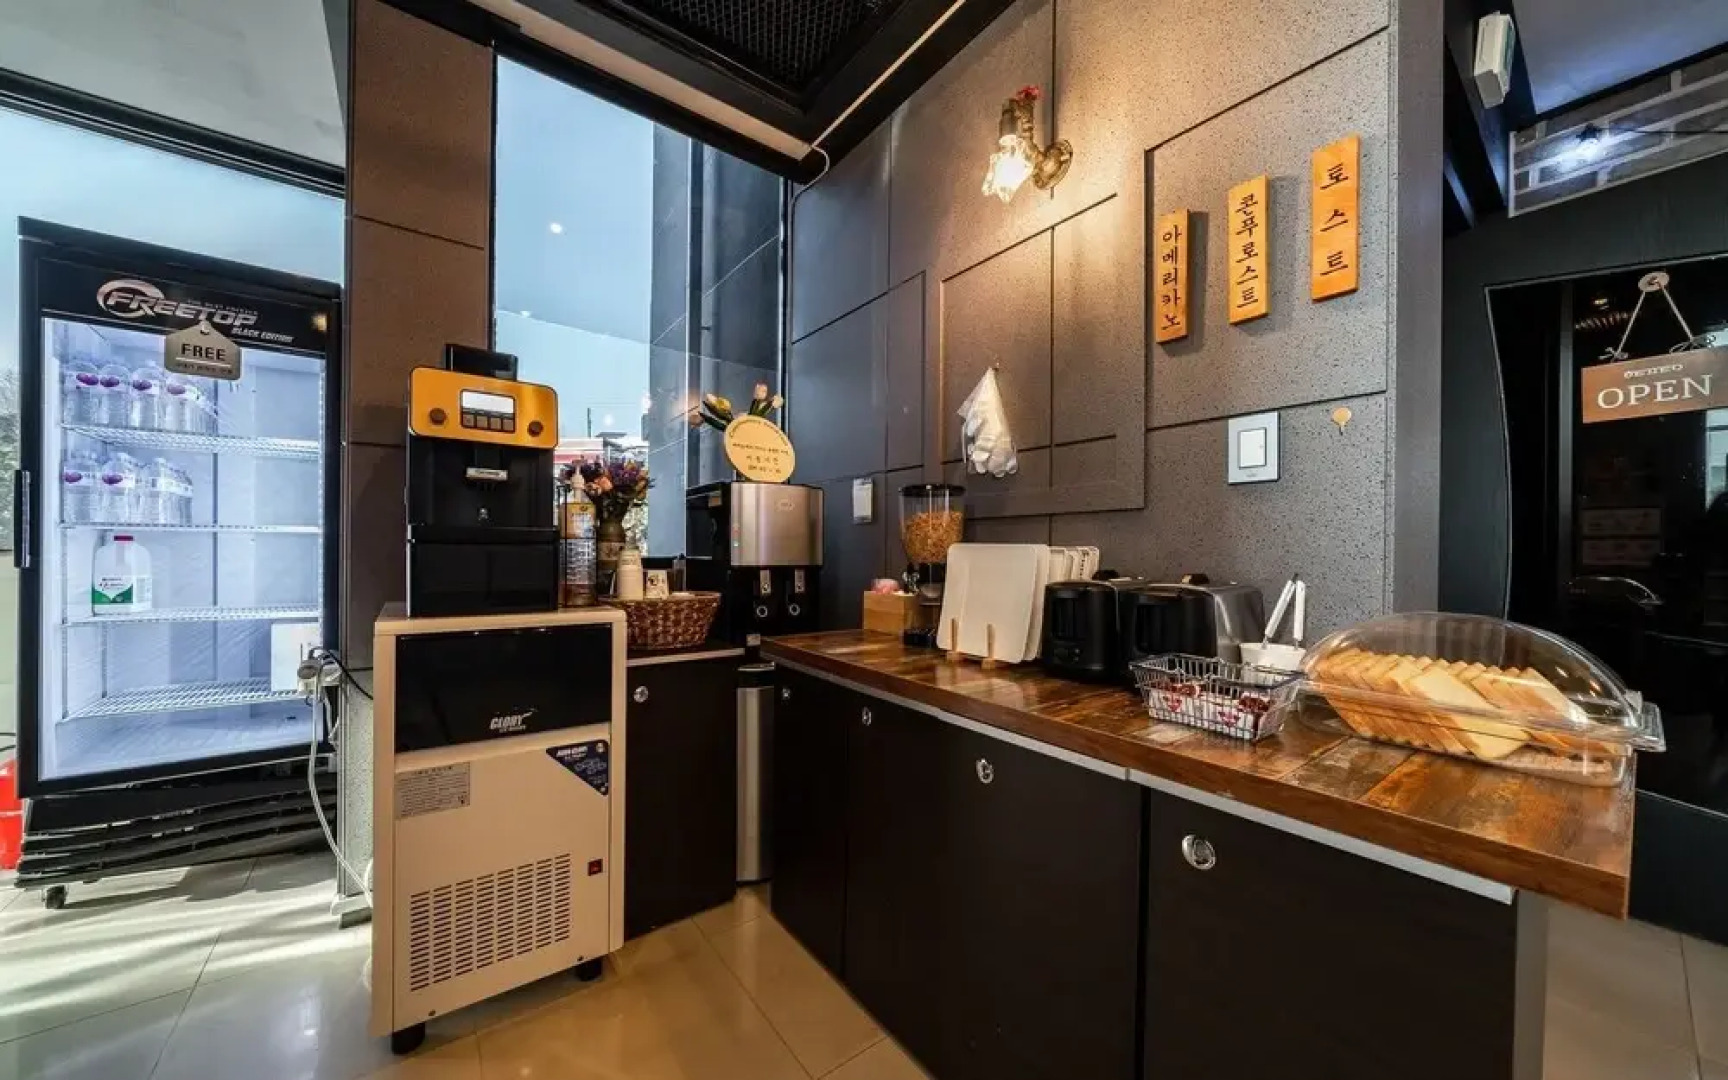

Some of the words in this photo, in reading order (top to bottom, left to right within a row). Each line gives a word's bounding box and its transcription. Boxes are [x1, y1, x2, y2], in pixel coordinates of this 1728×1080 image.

[1320, 162, 1348, 276] 토스트
[1235, 193, 1259, 309] 콘푸로스트
[1161, 224, 1182, 331] 아메리카노
[106, 290, 258, 326] FREETOP
[181, 343, 227, 361] FREE
[231, 327, 259, 338] BLACK
[260, 331, 294, 343] EDITION
[1597, 374, 1713, 409] OPEN
